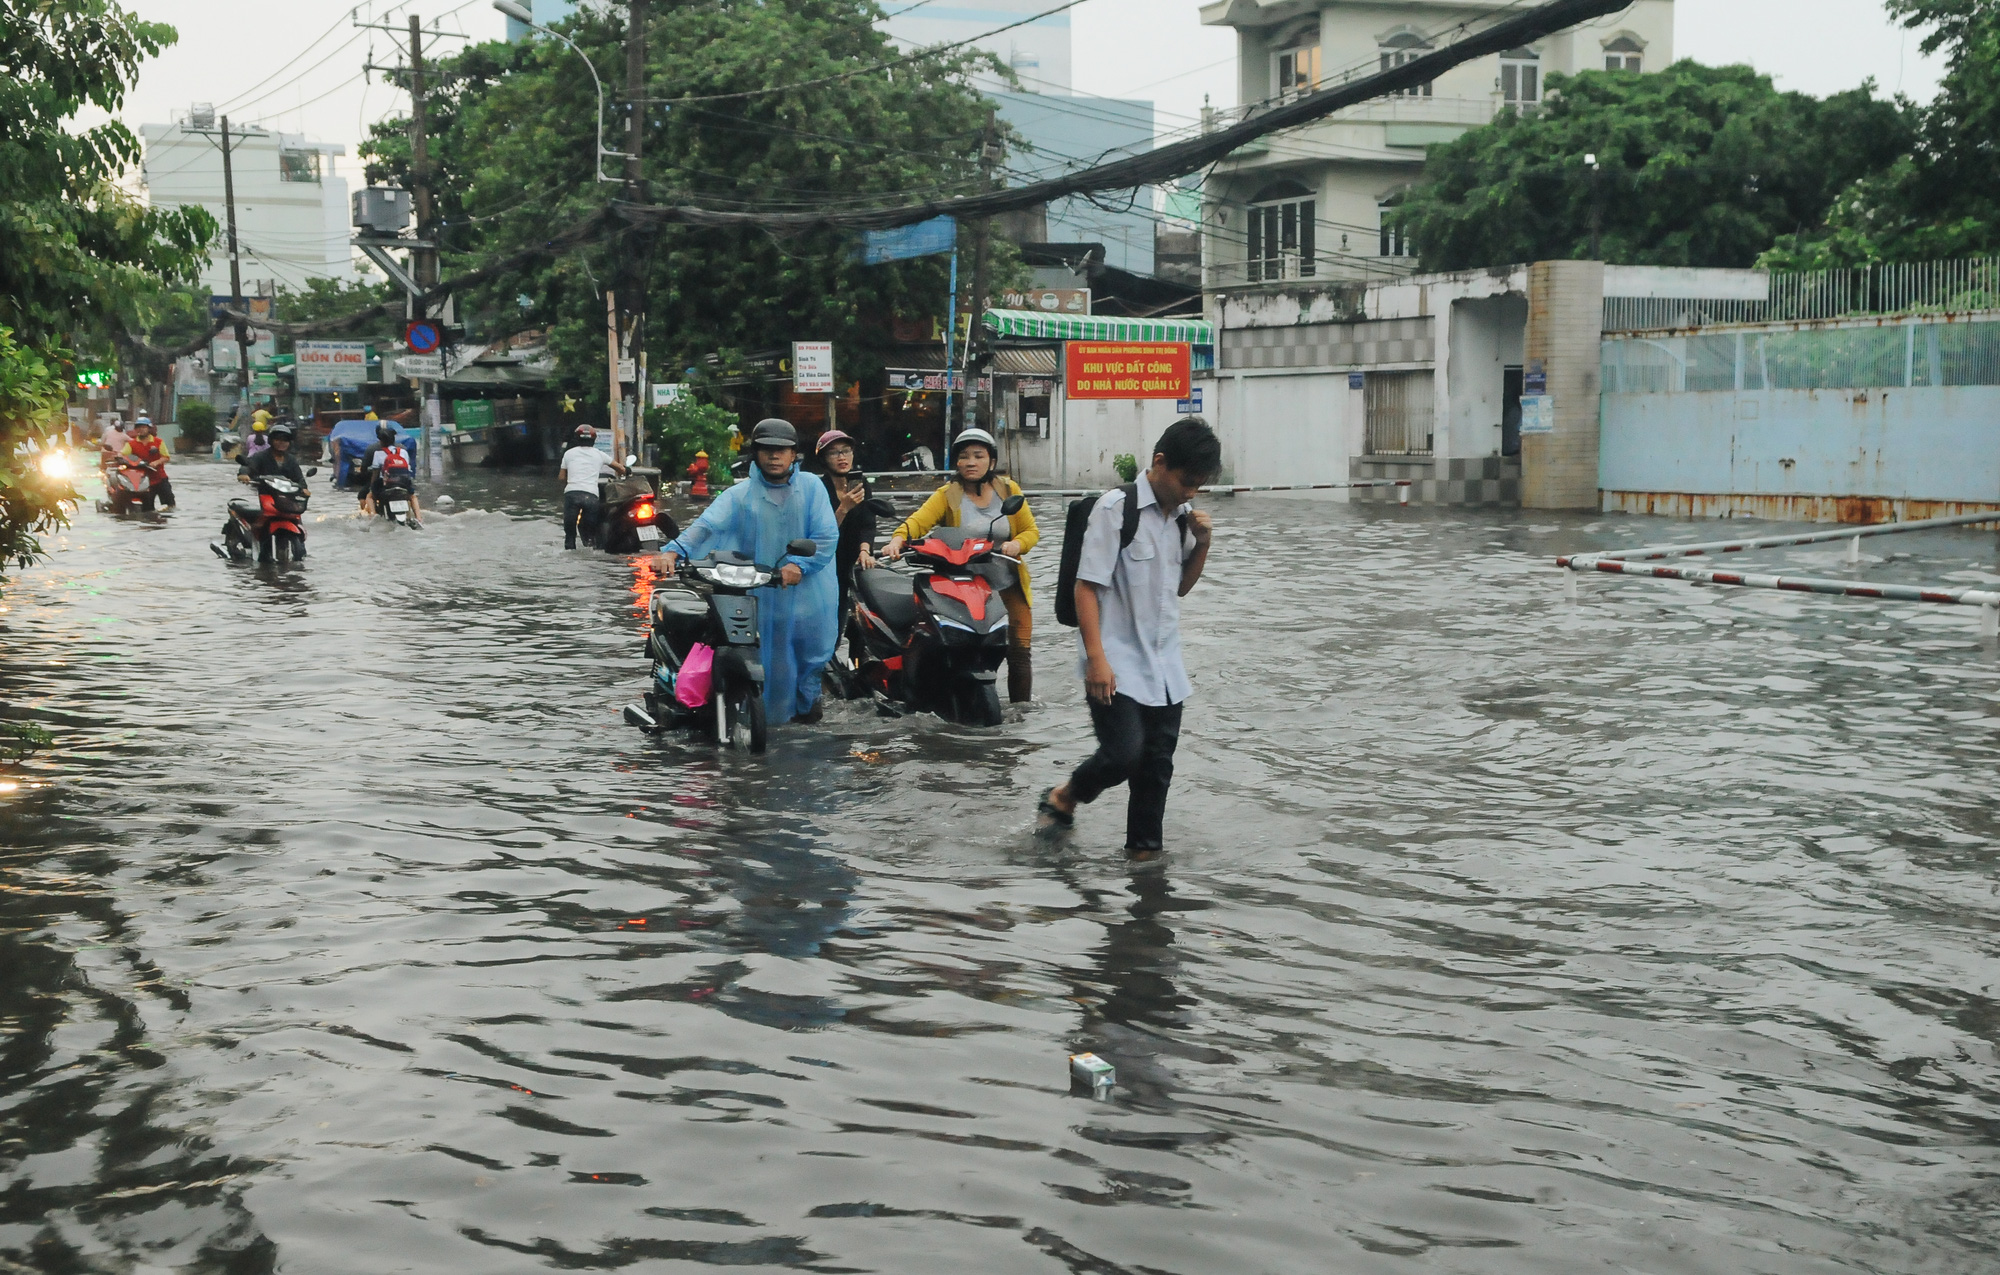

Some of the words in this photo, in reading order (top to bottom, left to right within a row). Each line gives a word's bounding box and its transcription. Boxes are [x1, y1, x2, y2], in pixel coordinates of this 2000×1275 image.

[301, 350, 329, 362] UỐN
[334, 350, 362, 363] ỐNG
[1083, 363, 1103, 373] KHU
[1105, 361, 1124, 375] VỰC
[1126, 360, 1145, 373] ĐẤT
[1147, 361, 1172, 373] CÔNG
[1077, 380, 1090, 390] DO
[1093, 378, 1112, 390] NHÀ
[1115, 378, 1140, 390] NƯỚC
[1142, 377, 1167, 391] QUẢN
[1169, 378, 1181, 390] LÝ
